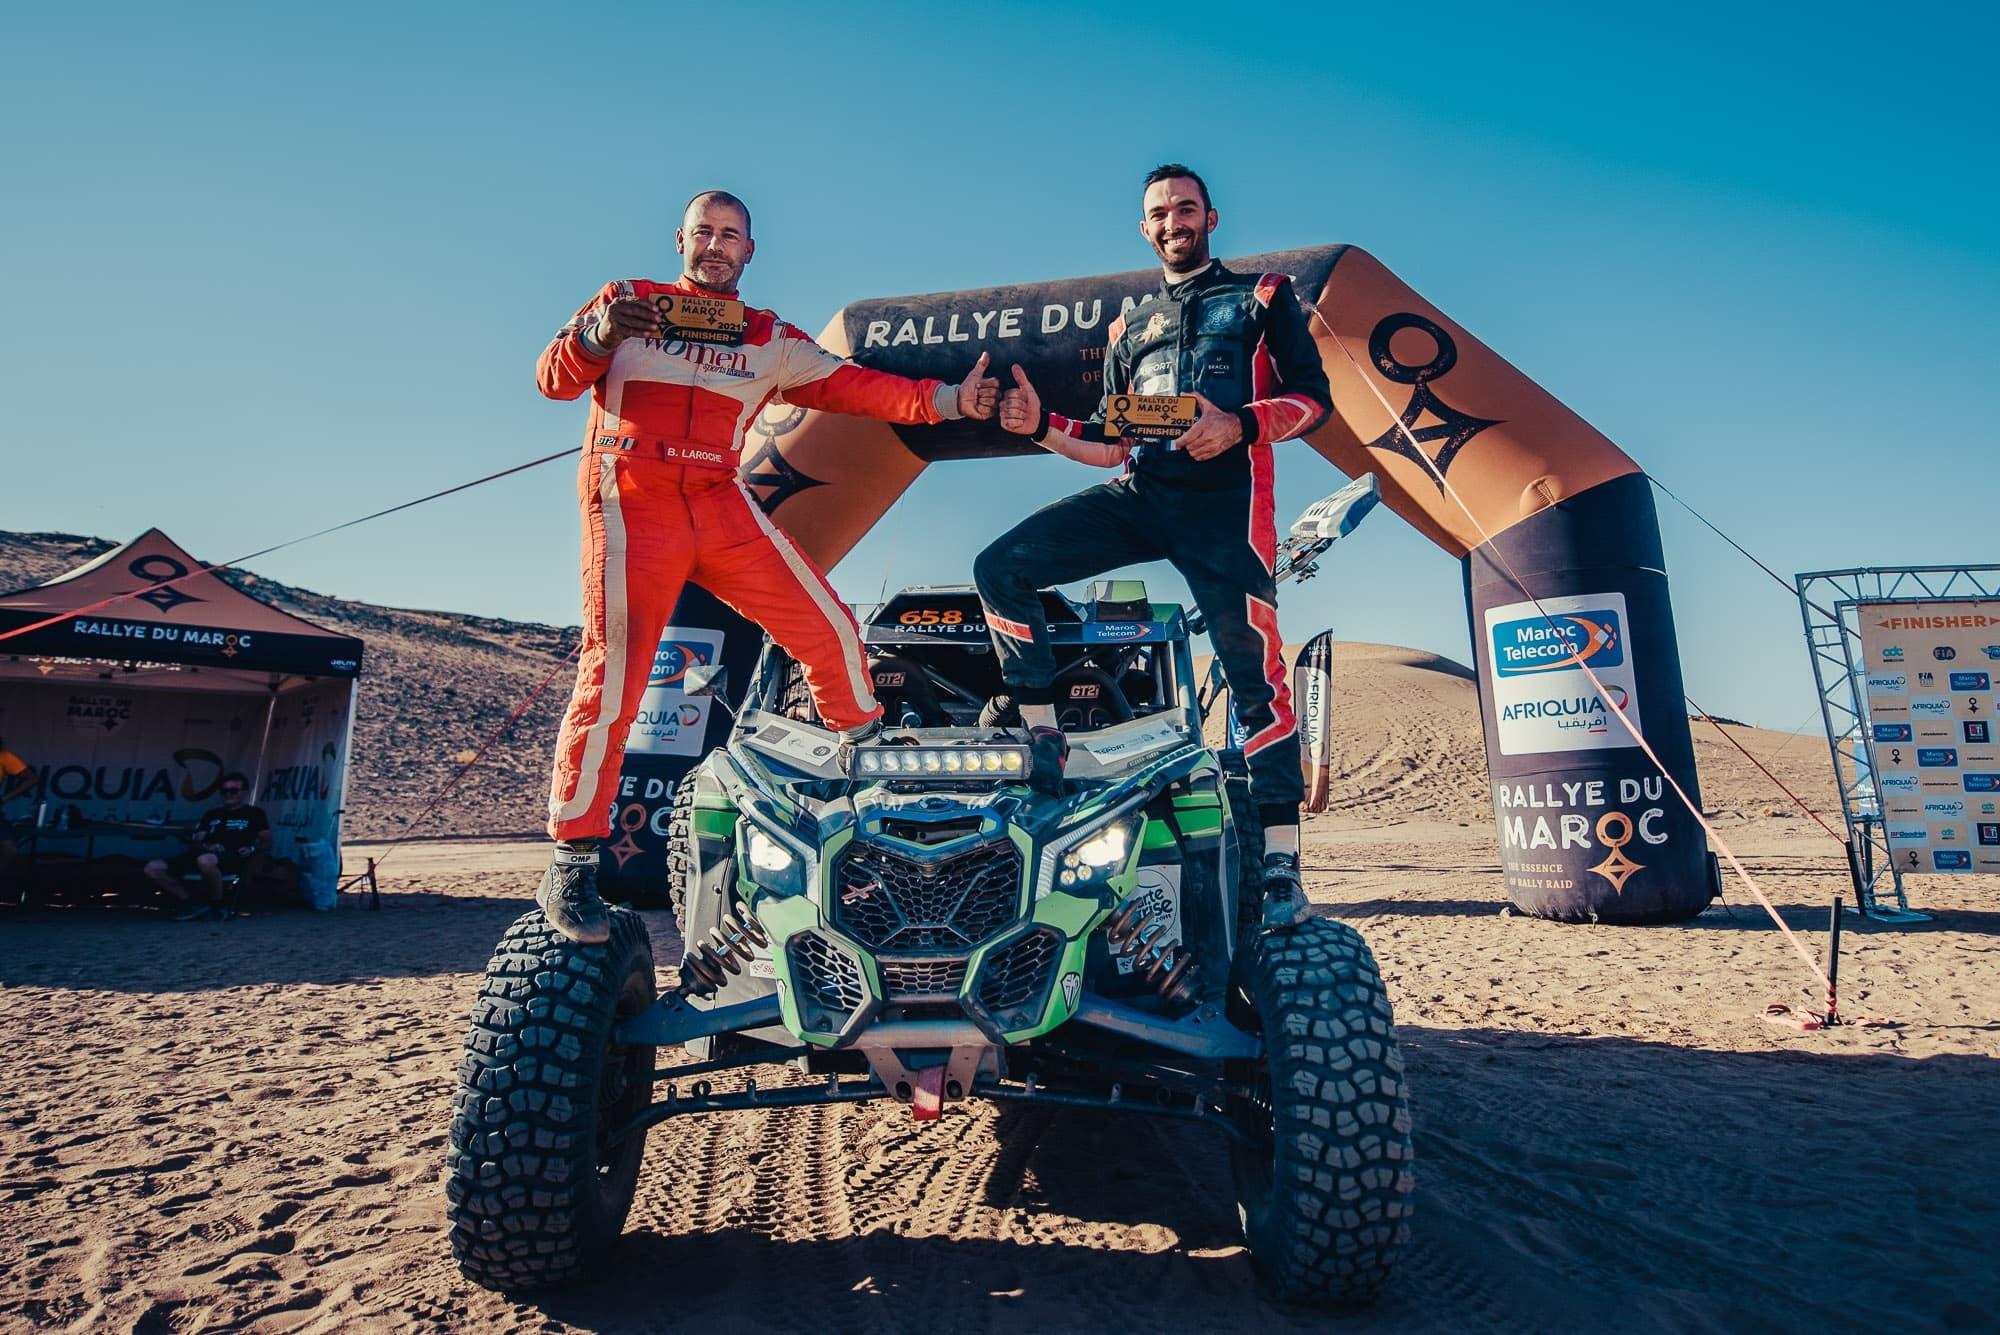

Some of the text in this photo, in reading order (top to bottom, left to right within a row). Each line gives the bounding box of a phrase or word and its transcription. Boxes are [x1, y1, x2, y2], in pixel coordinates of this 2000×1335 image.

[682, 297, 711, 306] RALLYE
[681, 306, 725, 317] MAROC
[718, 322, 741, 330] 2021
[864, 307, 1024, 349] RALLYE
[1041, 299, 1101, 334] DU
[682, 330, 730, 341] FINISHER
[1137, 405, 1178, 414] MAROC
[1137, 427, 1183, 436] FINISHER
[668, 447, 723, 463] B. LAROCHE
[899, 609, 962, 625] 658
[1891, 615, 1987, 630] FINISHER
[74, 620, 251, 649] RALLYE DU MAROC
[963, 624, 985, 632] DU
[1516, 624, 1577, 643] Maroc
[1503, 641, 1579, 661] Telecom
[876, 671, 906, 686] GT2i
[1070, 684, 1100, 698] GT2i
[1503, 696, 1607, 720] AFRIQUIA
[636, 711, 680, 726] QUIA
[1499, 775, 1663, 808] RALLYE DU
[1503, 808, 1669, 850] MAROC
[570, 855, 591, 863] OMP
[1521, 863, 1564, 873] ESSENCE
[1517, 878, 1543, 888] RALLY
[1546, 879, 1573, 889] RAID
